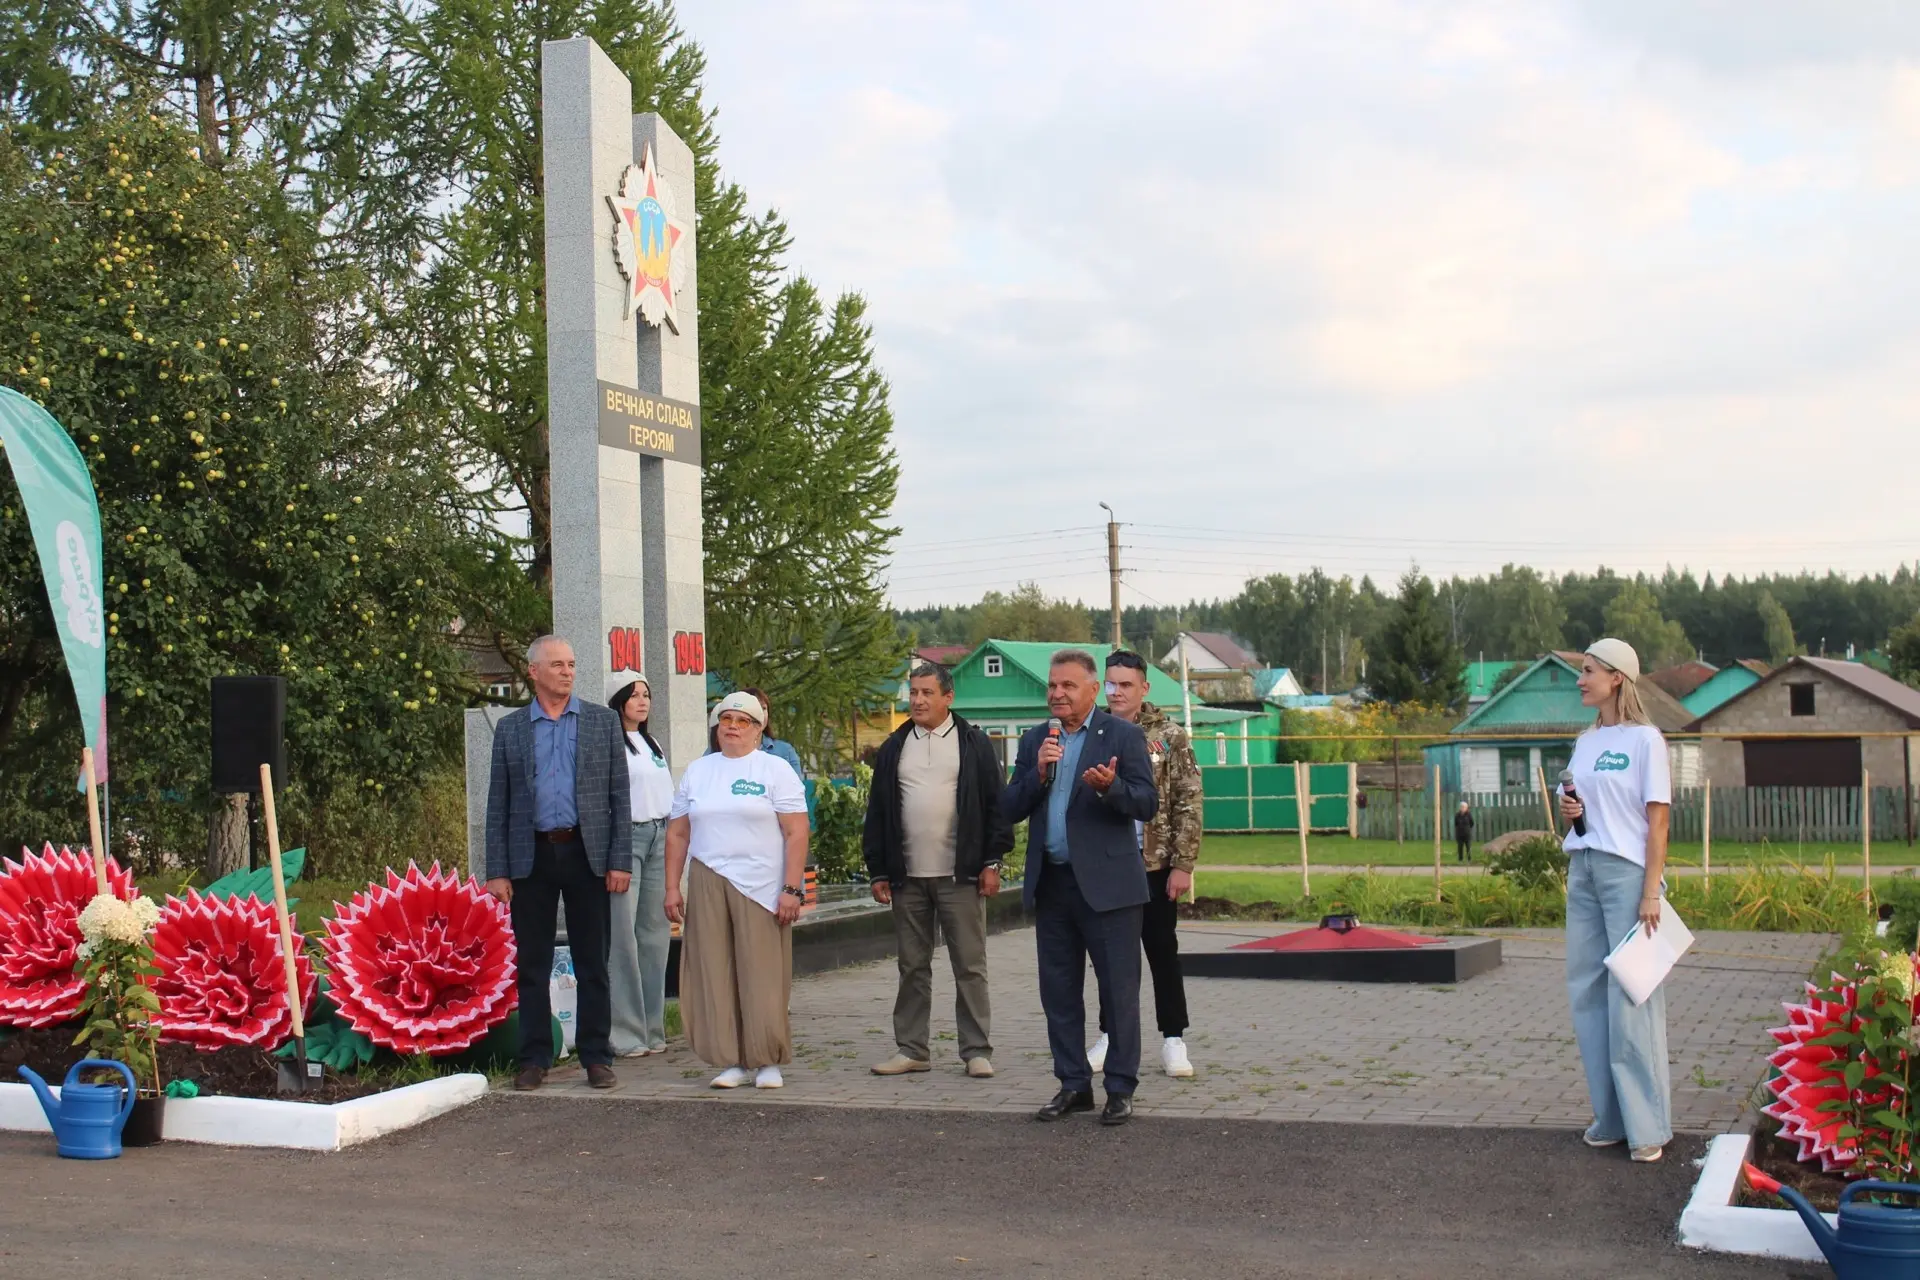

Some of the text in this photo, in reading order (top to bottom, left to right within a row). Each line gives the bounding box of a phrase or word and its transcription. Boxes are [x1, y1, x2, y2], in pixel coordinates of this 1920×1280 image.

[643, 201, 660, 215] СССР
[606, 389, 693, 430] ВЕЧНАЯ СЛАВА
[629, 424, 675, 453] ГЕРОЯМ
[608, 626, 641, 673] 1941
[673, 630, 705, 675] 1945
